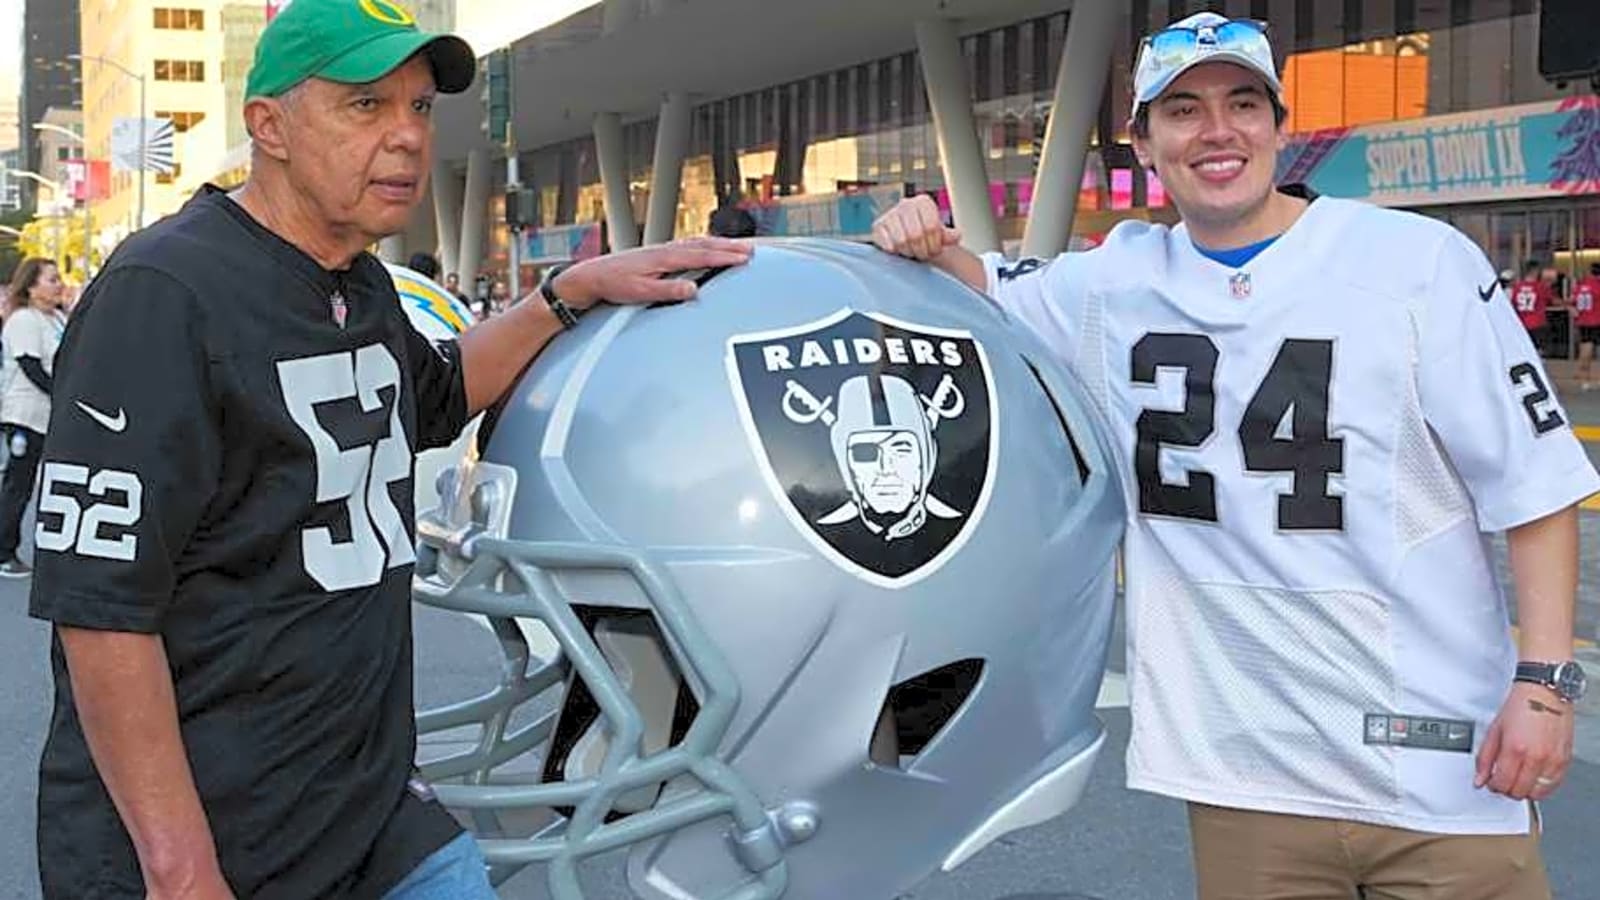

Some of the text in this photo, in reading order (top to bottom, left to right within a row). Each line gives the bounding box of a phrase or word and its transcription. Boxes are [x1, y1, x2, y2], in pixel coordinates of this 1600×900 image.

[1366, 125, 1526, 187] SUPER BOWL LX
[762, 338, 963, 372] RAIDERS
[275, 342, 417, 592] 52
[1129, 331, 1345, 532] 24
[35, 462, 143, 561] 52
